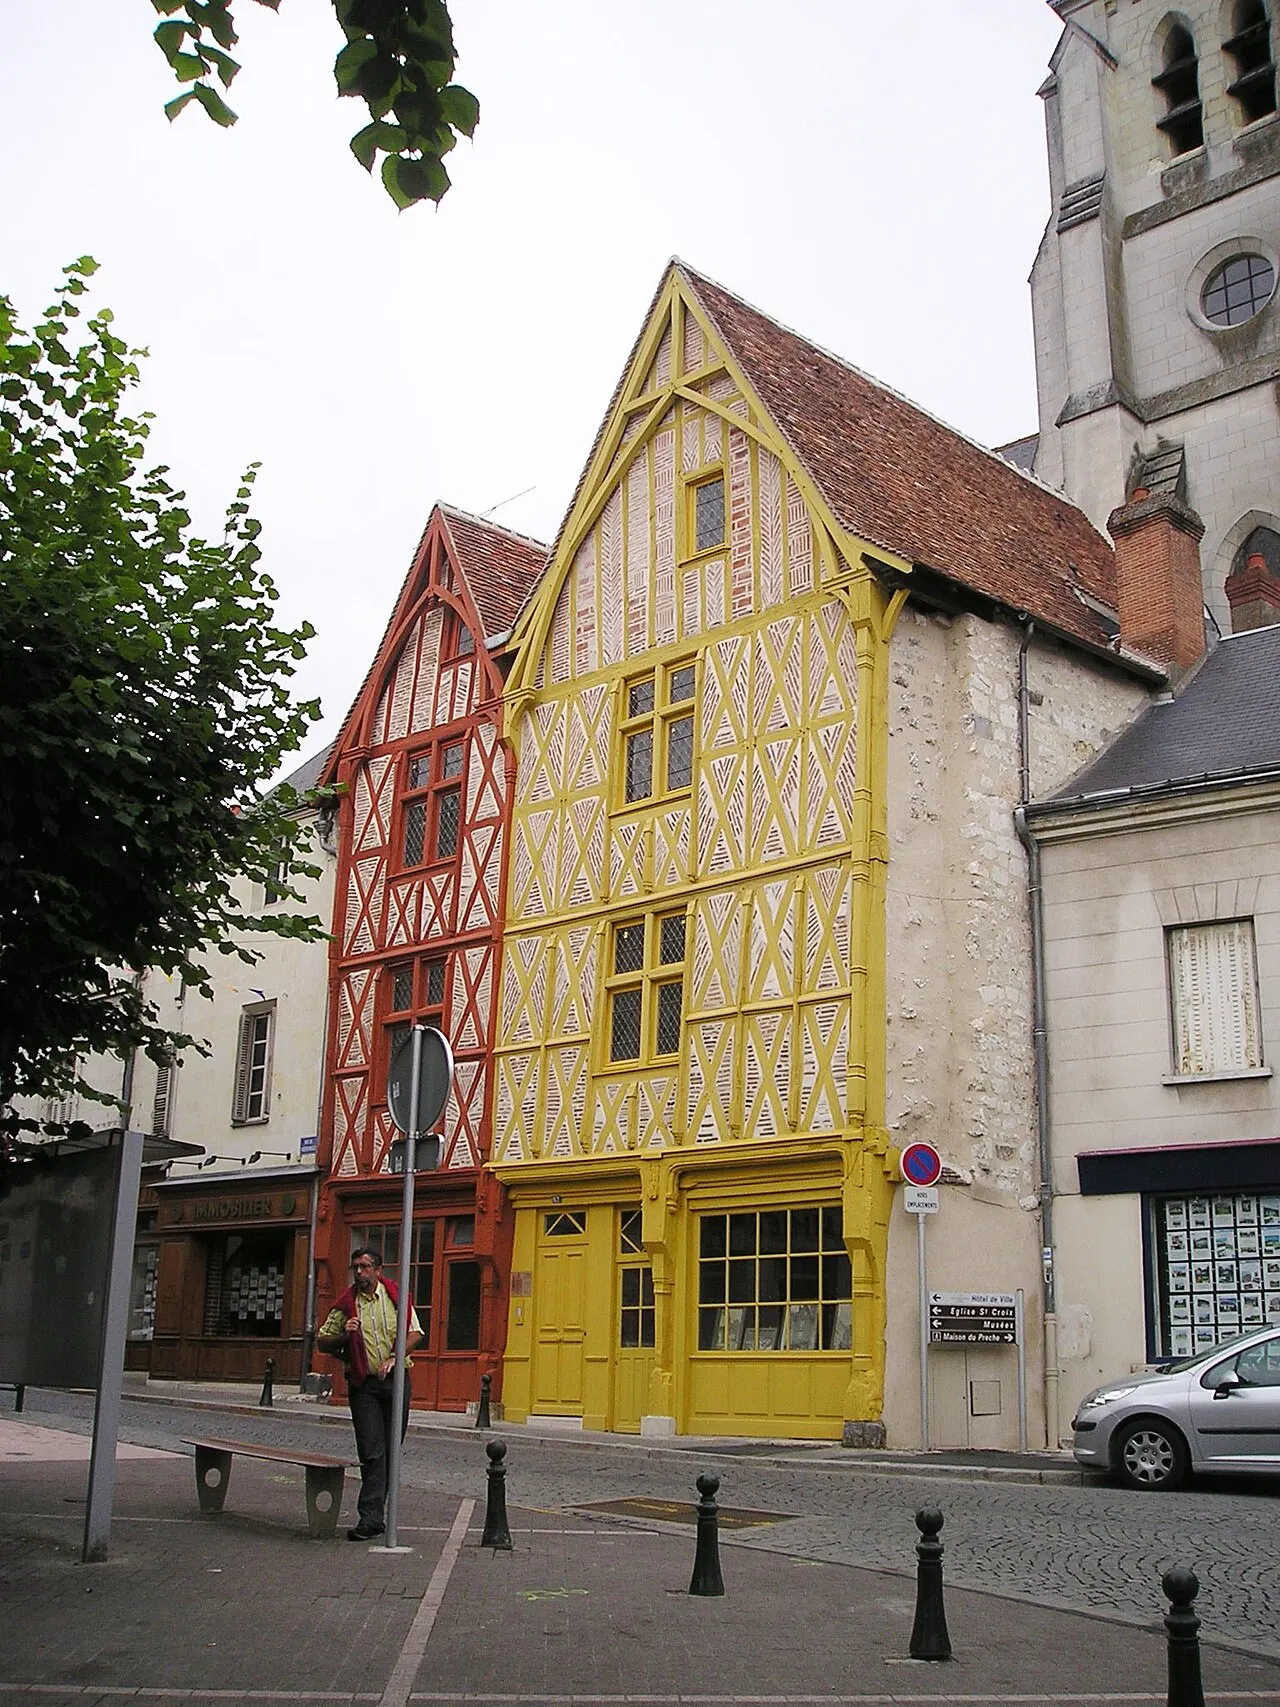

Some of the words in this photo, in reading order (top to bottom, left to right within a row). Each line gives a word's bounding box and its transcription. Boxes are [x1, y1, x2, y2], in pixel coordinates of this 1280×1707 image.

[194, 1198, 271, 1219] IMMOBILIER
[971, 1295, 988, 1303] Hôtel
[990, 1295, 997, 1303] de
[999, 1295, 1013, 1303] Ville
[950, 1307, 976, 1317] Eglise
[979, 1308, 988, 1316] St
[991, 1308, 1013, 1316] Croix
[983, 1320, 1014, 1329] Musées
[943, 1333, 966, 1341] Maison
[967, 1333, 976, 1341] du
